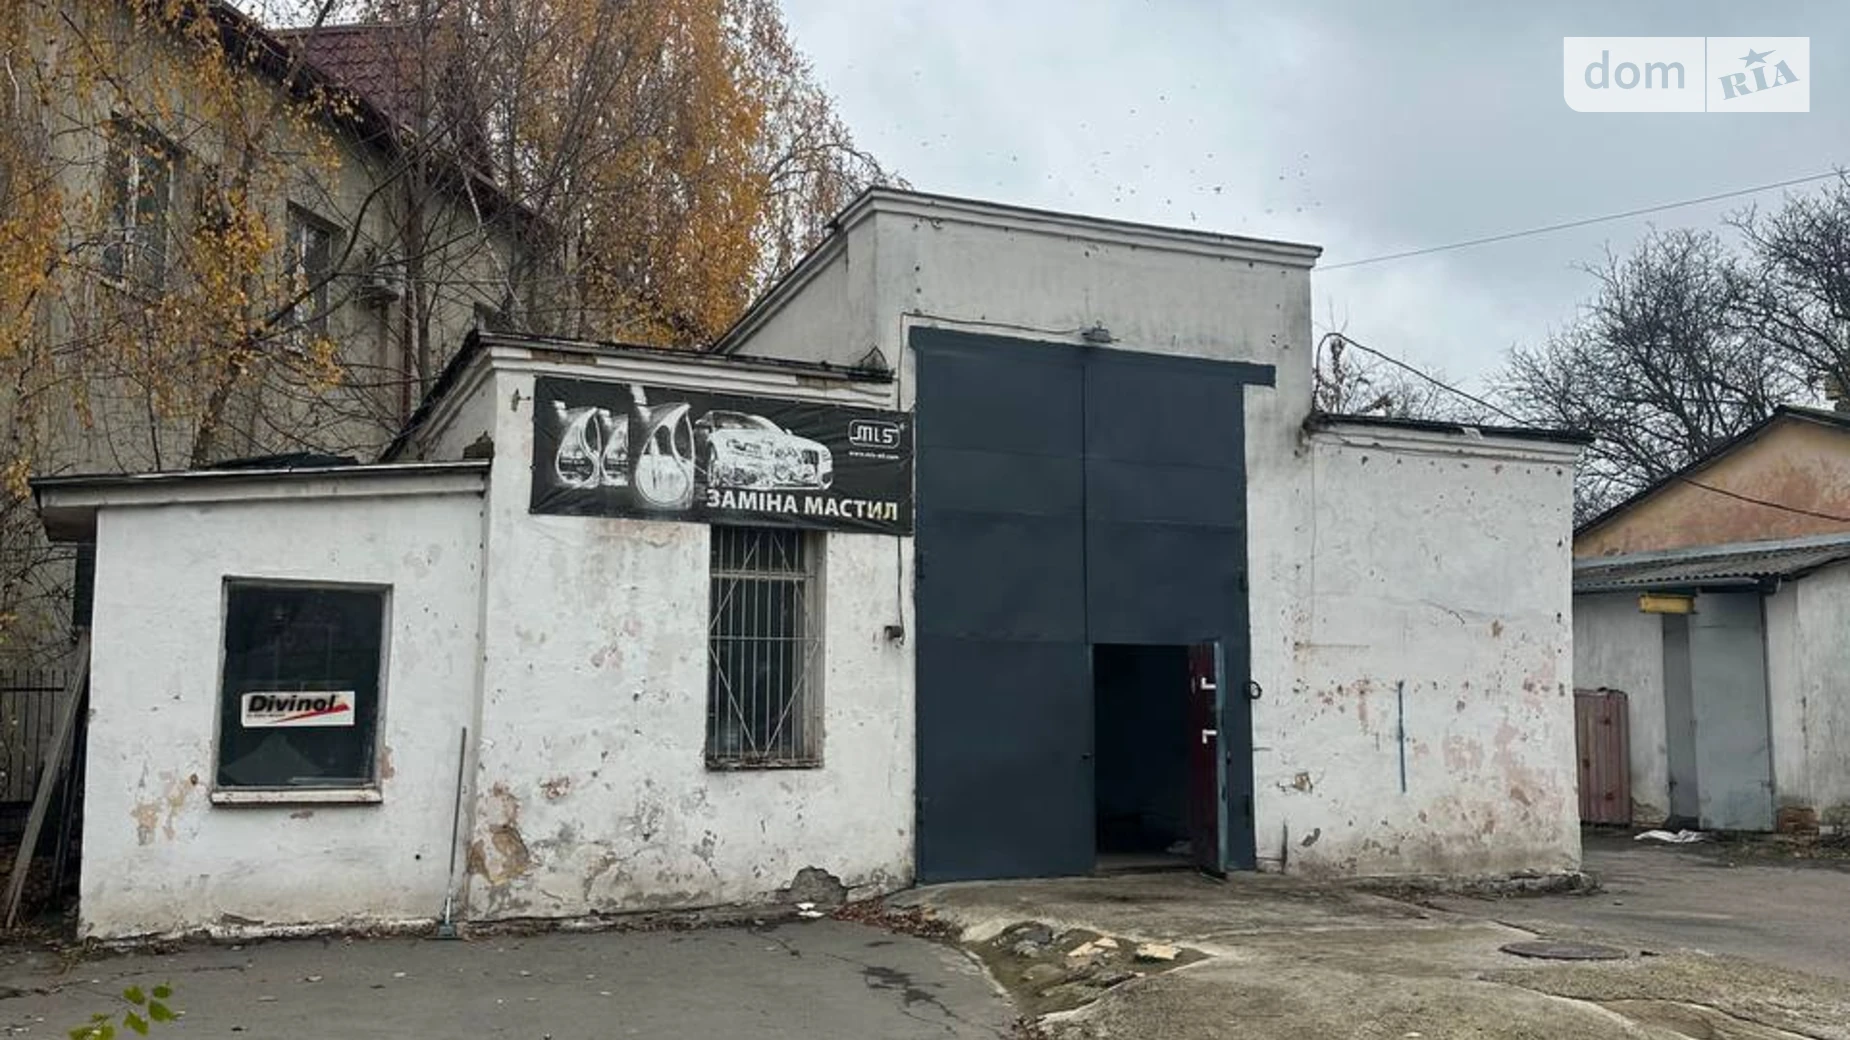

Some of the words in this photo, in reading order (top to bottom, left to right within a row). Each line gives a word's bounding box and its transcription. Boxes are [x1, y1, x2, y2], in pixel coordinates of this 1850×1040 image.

[706, 488, 798, 514] ЗАМІНА
[803, 496, 898, 521] МАСТИЛ
[247, 693, 336, 713] Divinol
